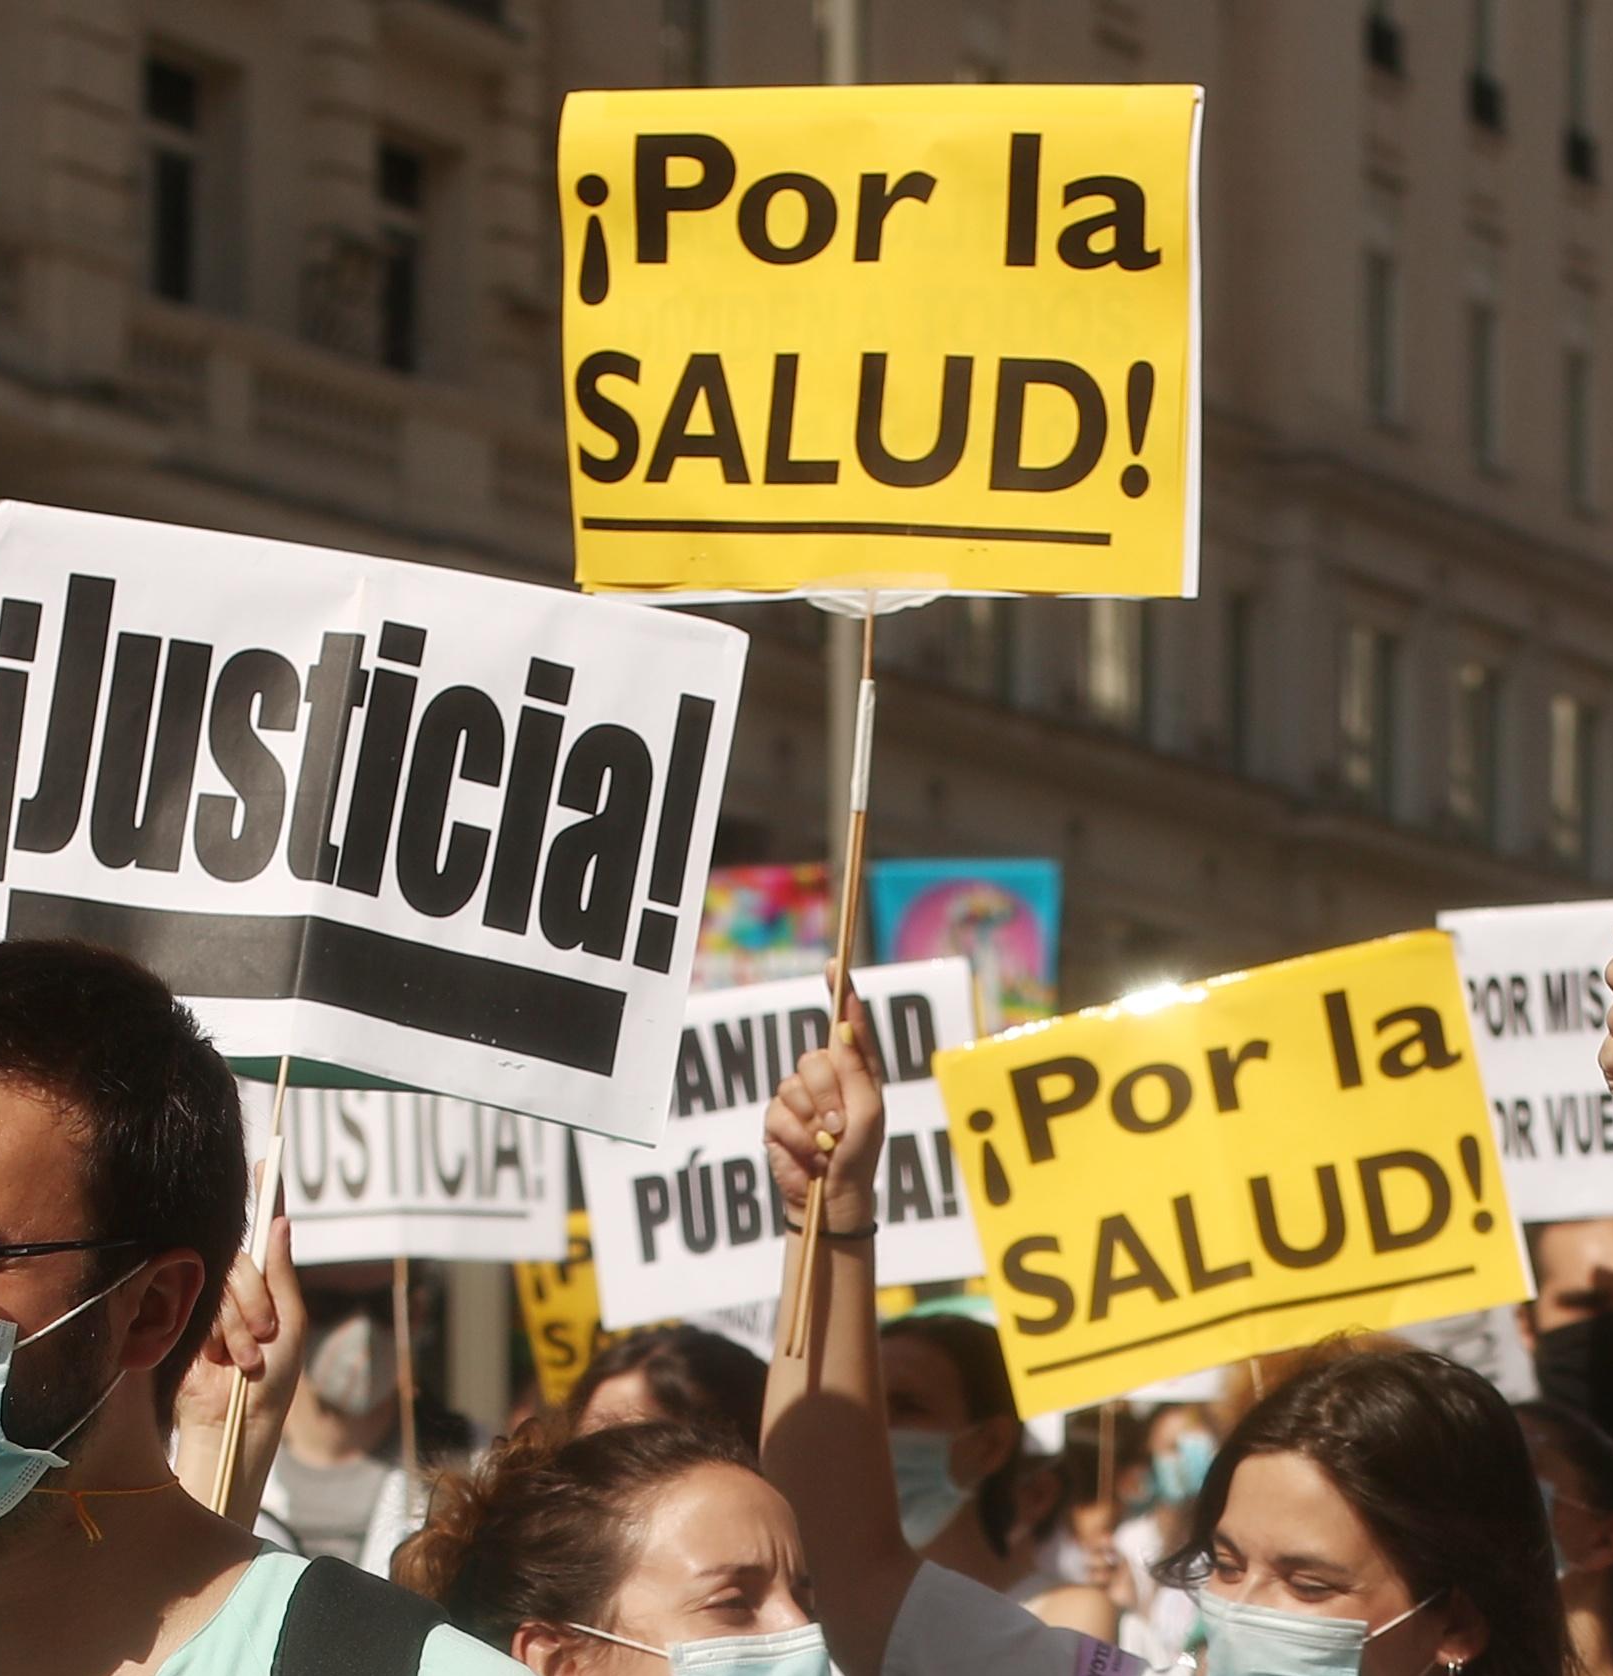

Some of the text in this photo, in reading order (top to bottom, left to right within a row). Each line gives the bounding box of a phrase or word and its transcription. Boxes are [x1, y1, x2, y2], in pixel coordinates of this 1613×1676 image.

[576, 132, 1162, 306] ¡Por la
[574, 349, 1155, 499] SALUD!
[966, 988, 1462, 1208] ¡Por la
[1000, 1134, 1495, 1335] SALUD!
